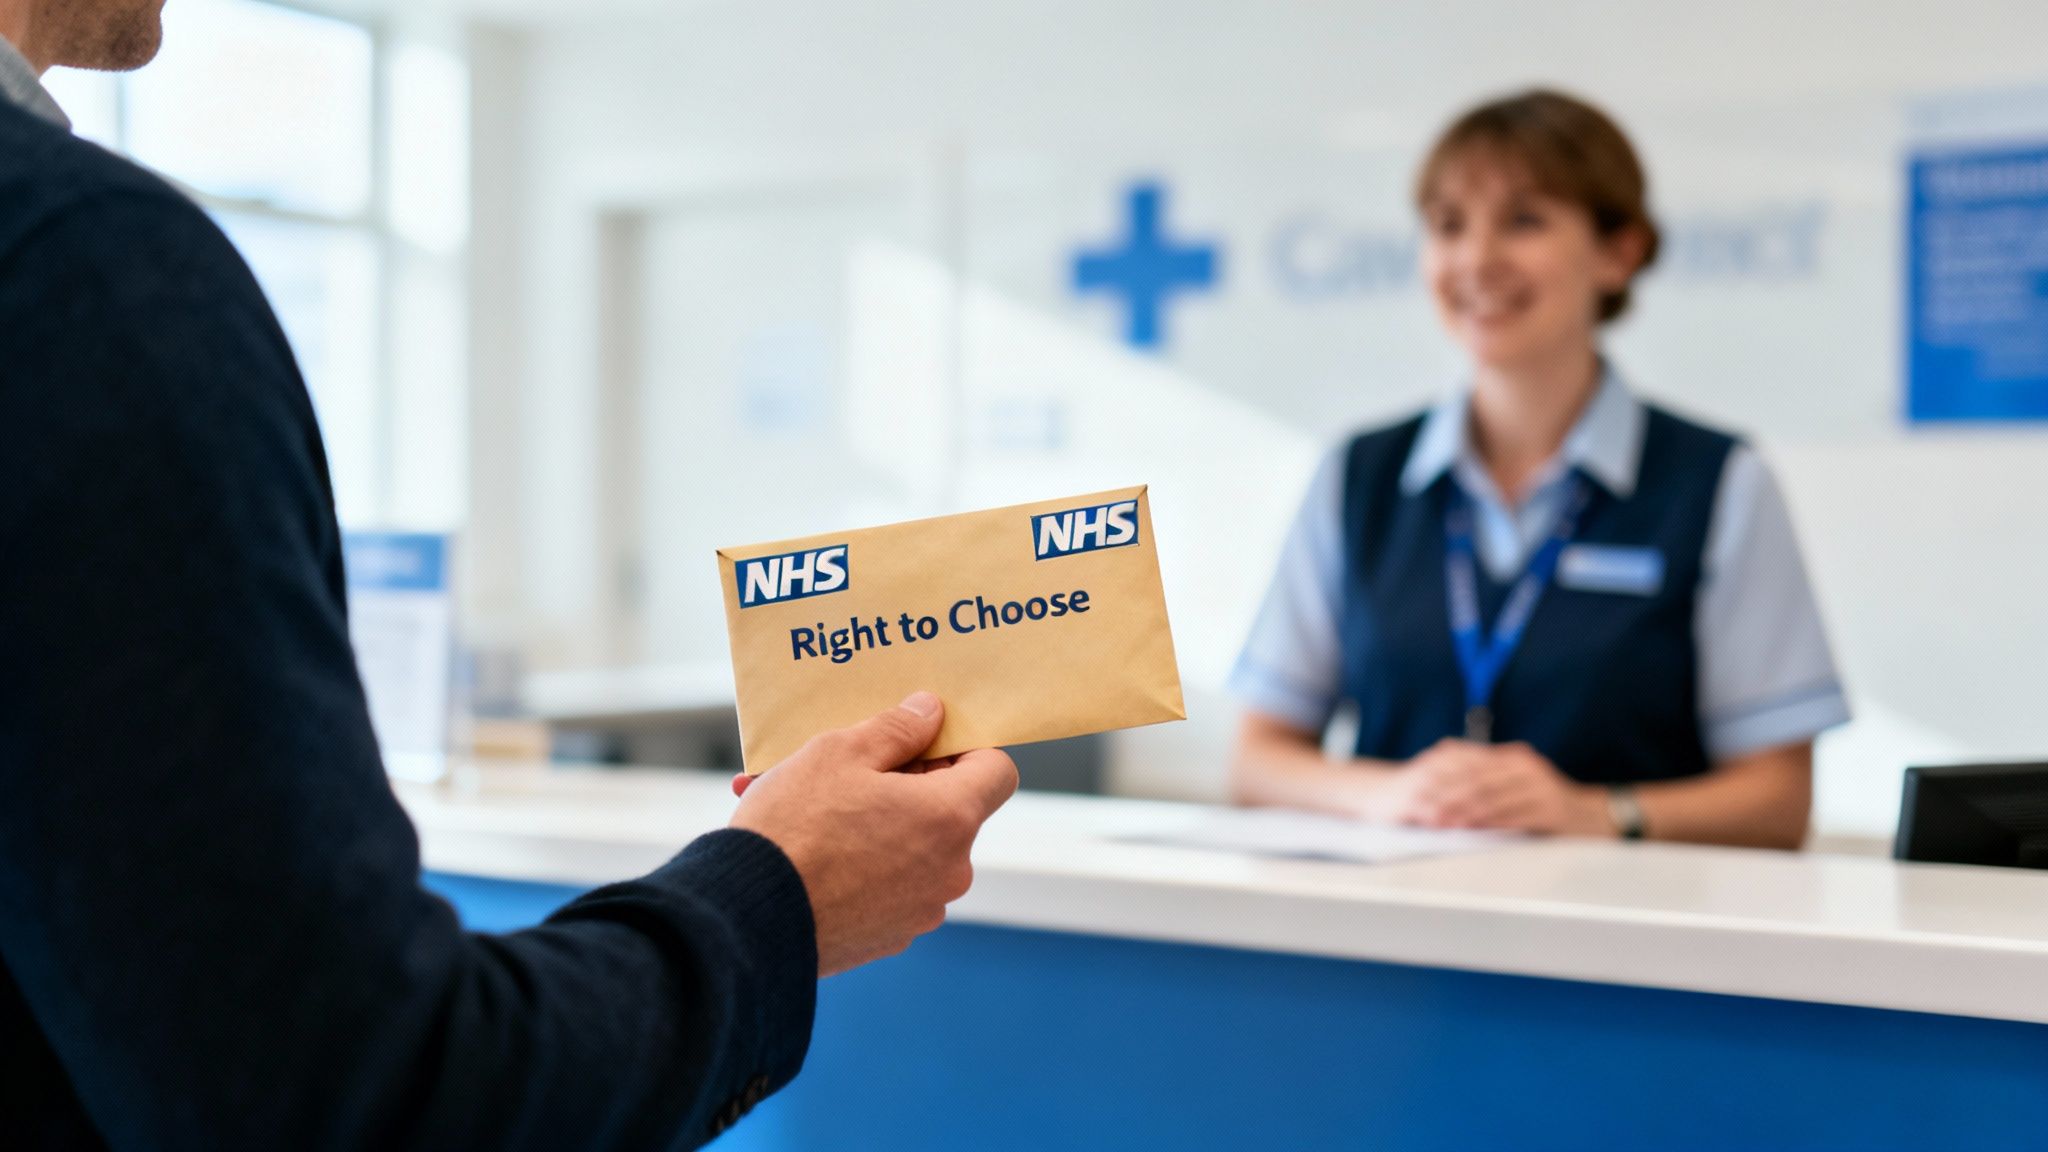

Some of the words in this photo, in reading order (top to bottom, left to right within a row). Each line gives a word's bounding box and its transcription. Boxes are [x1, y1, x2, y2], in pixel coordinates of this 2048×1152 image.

[1037, 502, 1139, 556] NHS
[743, 548, 848, 604] NHS
[790, 616, 891, 663] Right
[901, 612, 938, 642] to
[949, 589, 1090, 634] Choose
